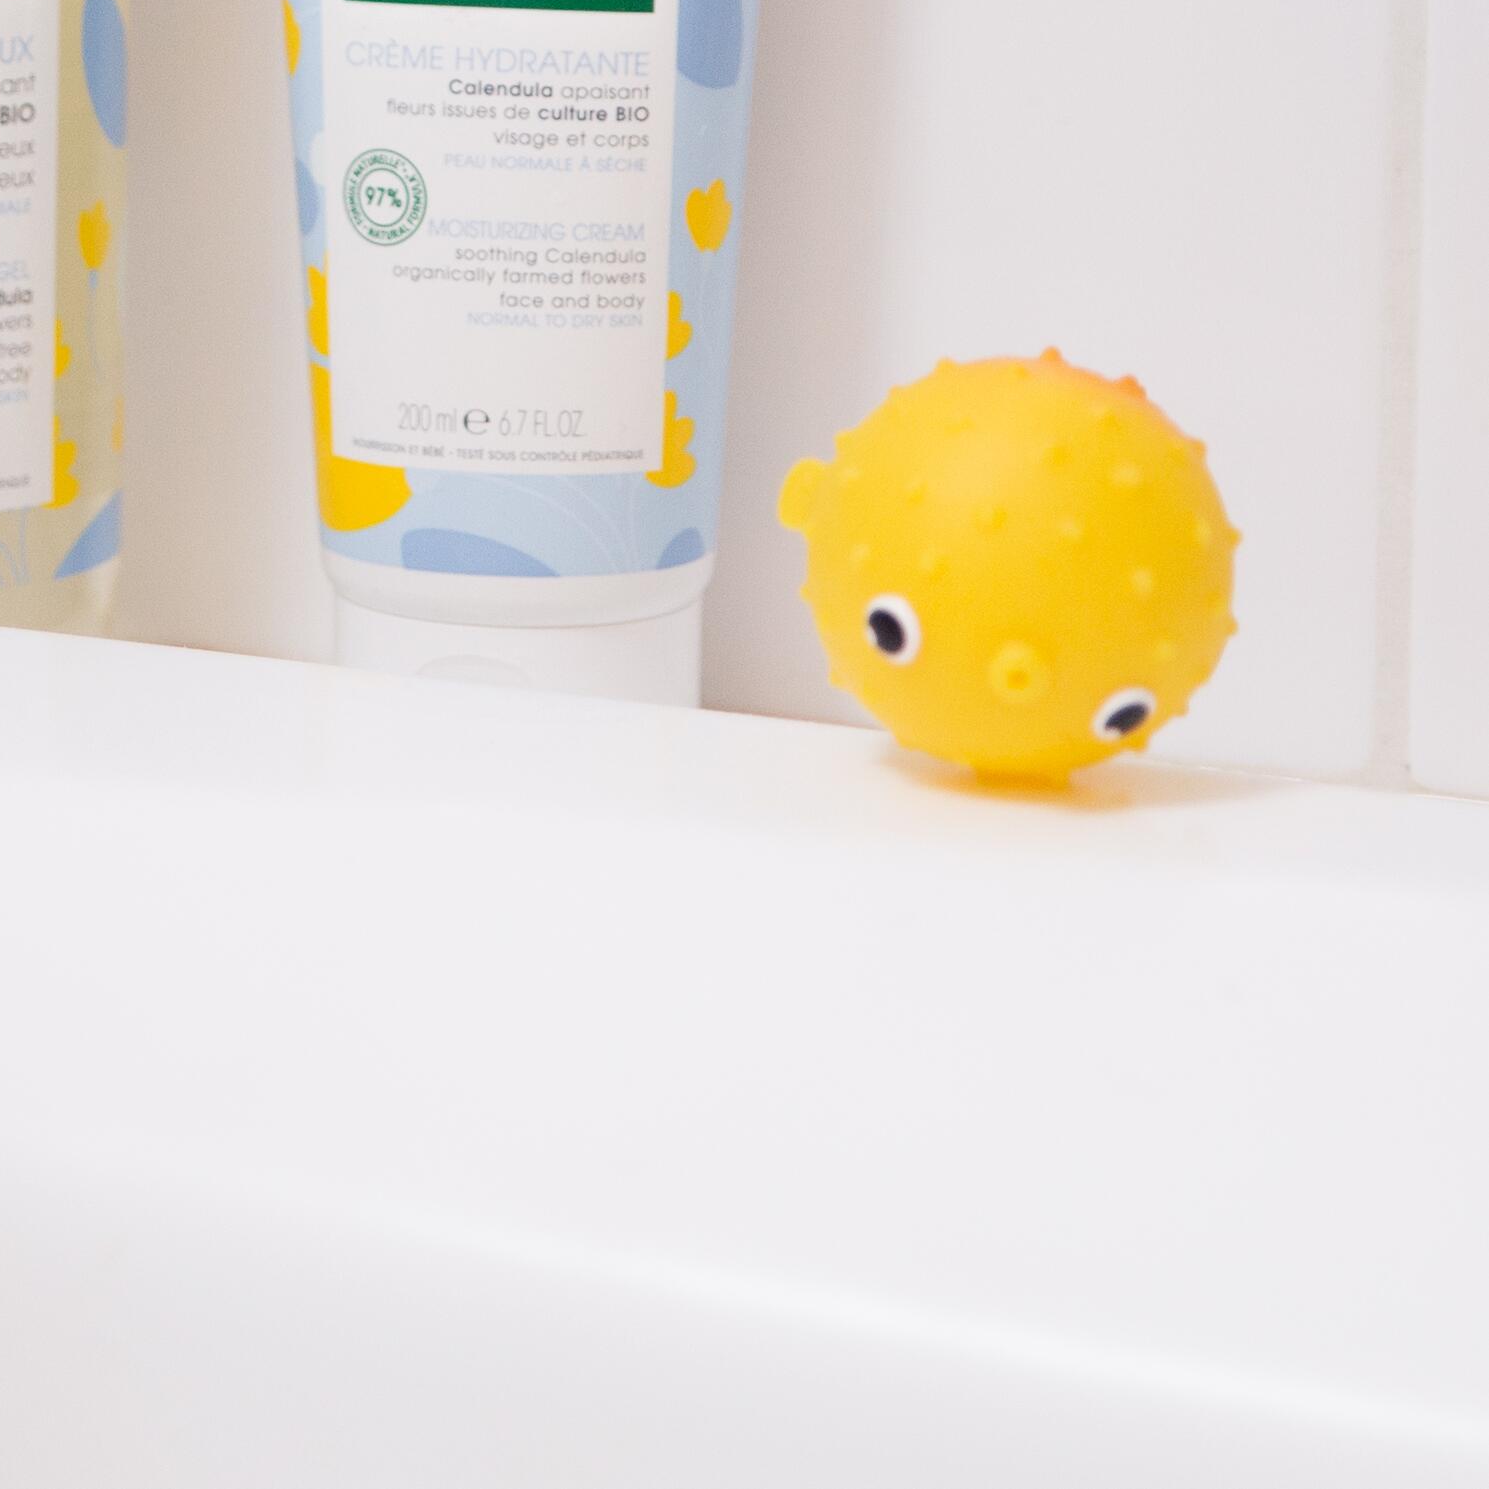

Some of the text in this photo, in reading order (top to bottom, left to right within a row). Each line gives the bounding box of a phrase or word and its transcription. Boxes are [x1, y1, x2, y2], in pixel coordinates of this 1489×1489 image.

[345, 39, 649, 78] CRÈME HYDRATANTE
[449, 78, 649, 102] Calendula apaisant
[0, 102, 35, 124] BIO
[386, 98, 650, 122] fleurs issues de culture BIO
[493, 128, 649, 150] visage et corps
[444, 153, 487, 169] PEAU
[492, 154, 573, 171] NORMALE
[365, 186, 402, 209] 97%
[427, 218, 646, 242] MOISTURIZING CREAM
[455, 246, 646, 266] soothing Calendula
[392, 264, 646, 286] organically farmed flowers
[500, 291, 645, 312] face and body
[466, 312, 643, 328] NORMAL TO DRY SKIN
[397, 402, 432, 432] 200
[436, 408, 457, 434] ml
